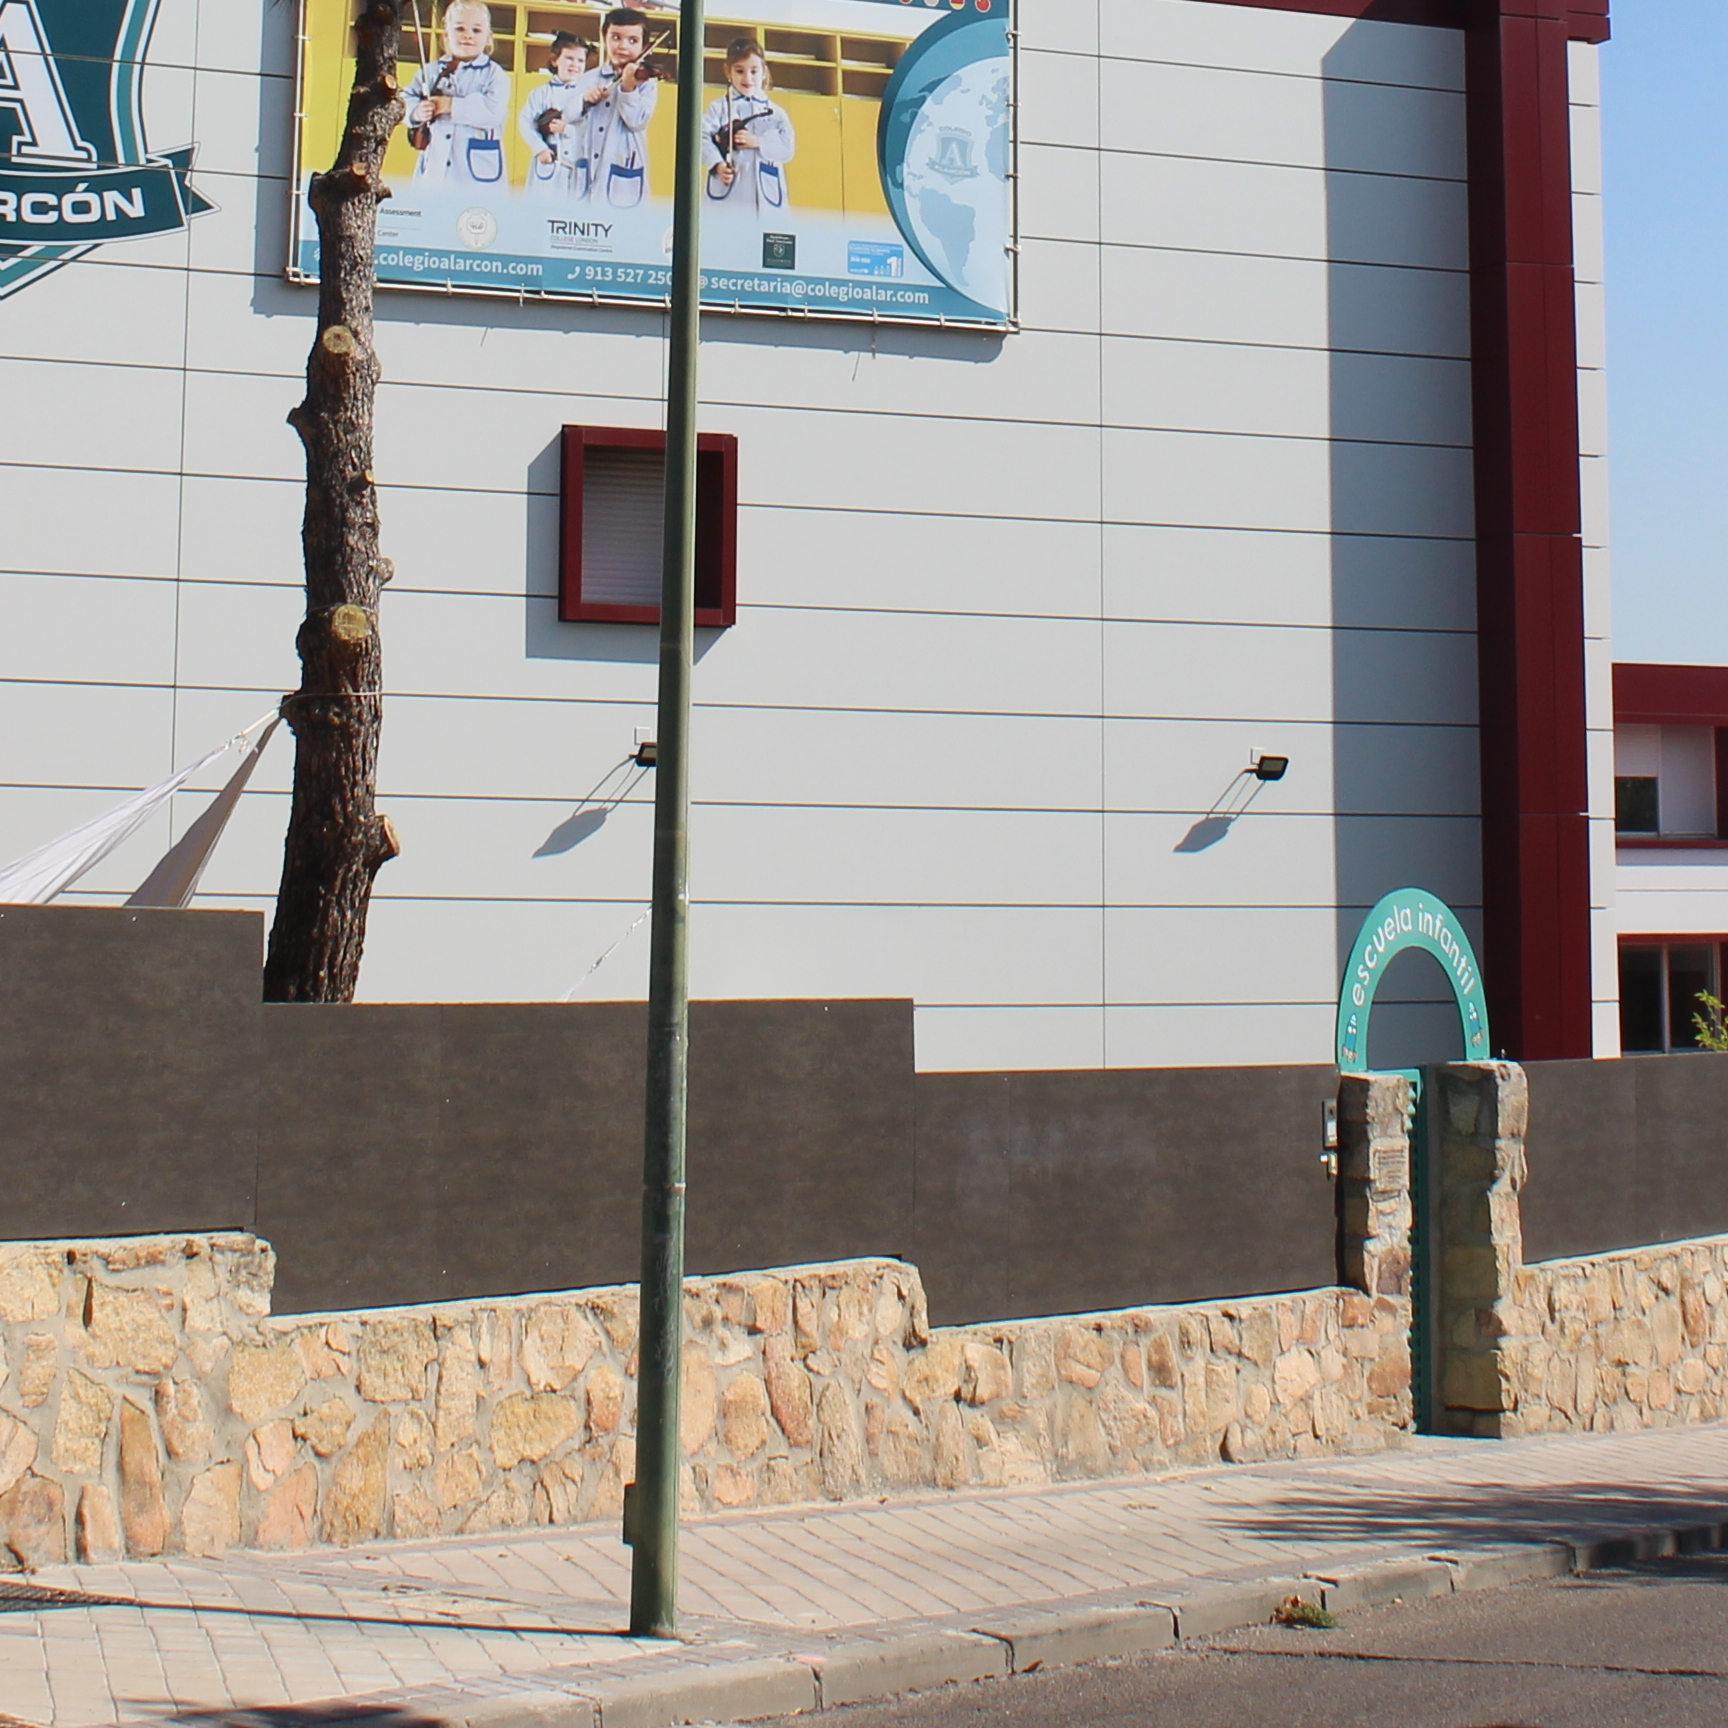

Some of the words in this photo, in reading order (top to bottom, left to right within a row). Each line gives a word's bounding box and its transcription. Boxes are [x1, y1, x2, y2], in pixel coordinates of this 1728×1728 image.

[547, 219, 613, 238] TRINITY
[374, 250, 543, 277] .colegioalarcon.com
[585, 265, 612, 281] 913
[616, 268, 644, 283] 527
[711, 274, 929, 305] secretaria@colegioalar.com
[1353, 905, 1412, 1007] escuela
[1418, 902, 1475, 995] infantil
